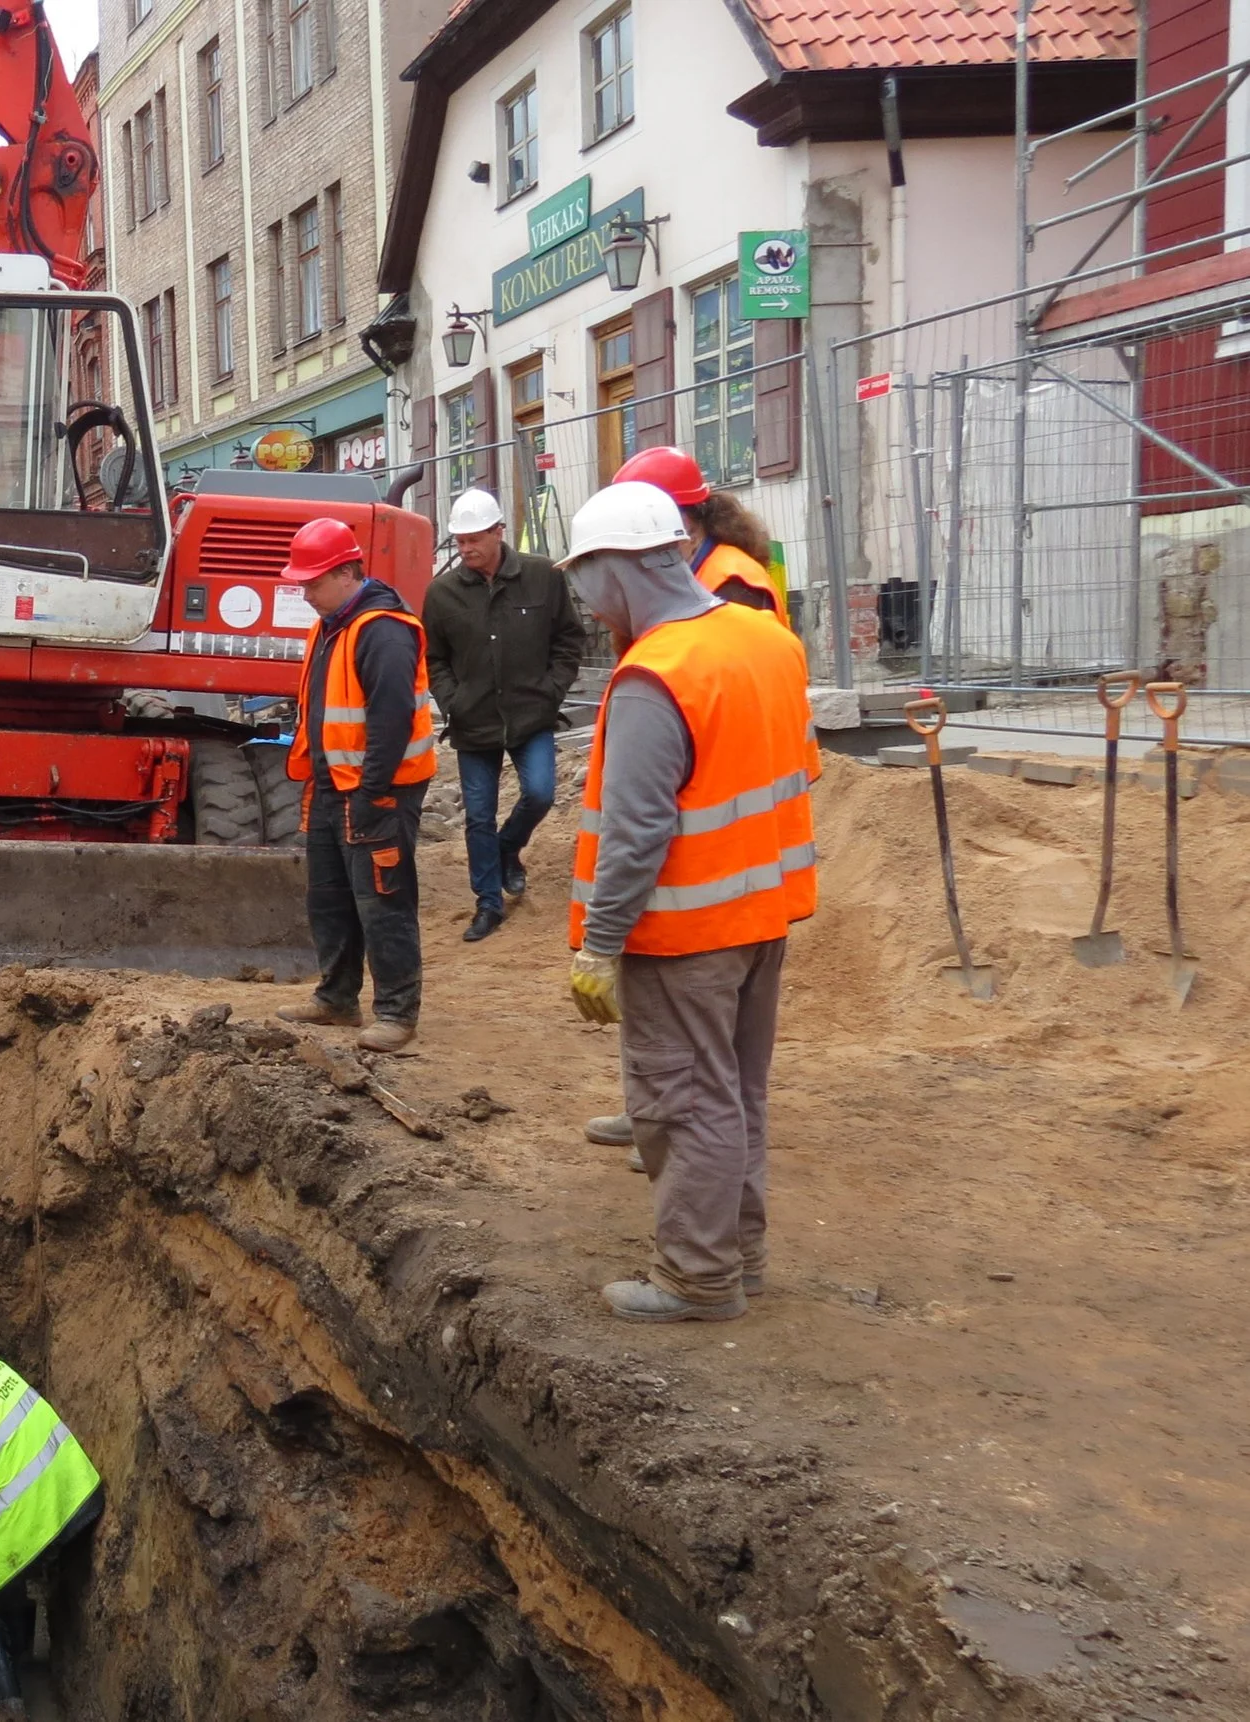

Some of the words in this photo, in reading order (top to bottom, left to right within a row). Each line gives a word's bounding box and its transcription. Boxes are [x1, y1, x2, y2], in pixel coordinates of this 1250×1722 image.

[531, 198, 585, 249] VEIKALS
[756, 275, 795, 285] APAVU
[749, 285, 802, 295] REMONTS
[183, 631, 307, 660] LIEBHE
